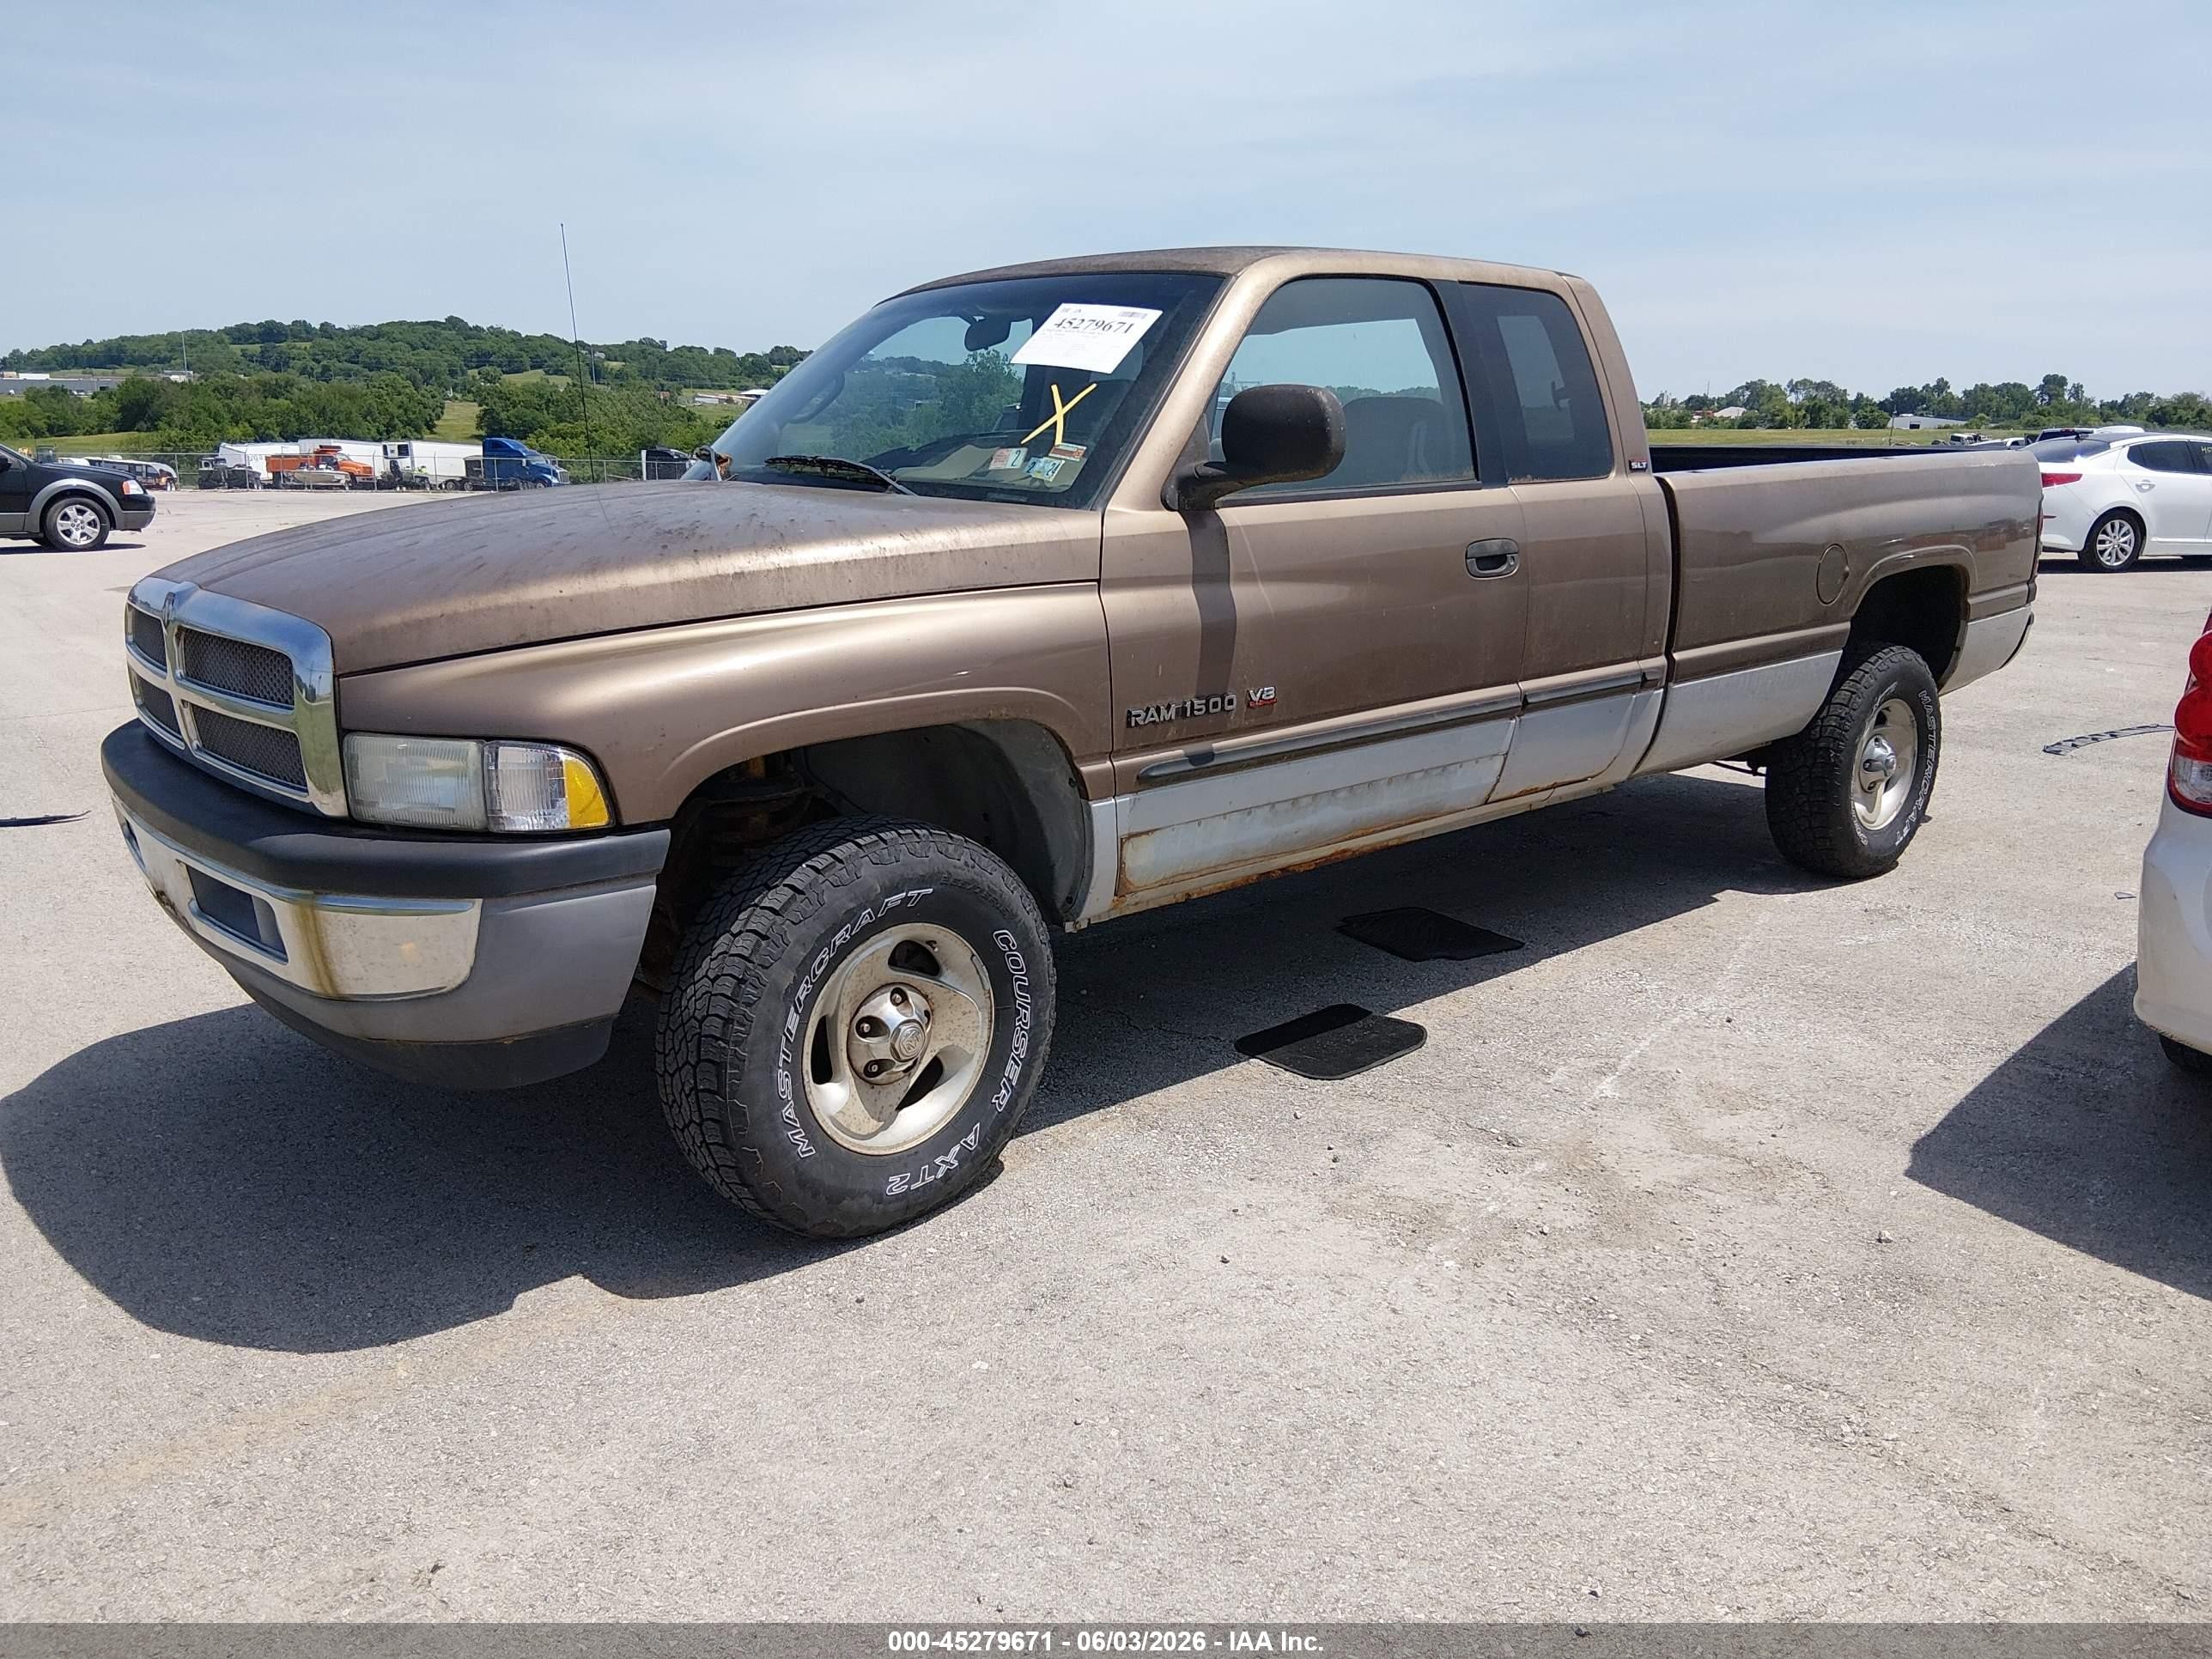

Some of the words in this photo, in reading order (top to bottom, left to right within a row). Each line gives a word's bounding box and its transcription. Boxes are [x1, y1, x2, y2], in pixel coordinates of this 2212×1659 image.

[1054, 317, 1135, 334] 45279671
[1129, 703, 1176, 727] RAM
[1184, 693, 1237, 718] 1500
[1249, 686, 1276, 702] V8
[776, 887, 933, 1158] MASTERCRAFT
[992, 928, 1031, 1113] COURSER
[884, 1121, 981, 1196] AXT2
